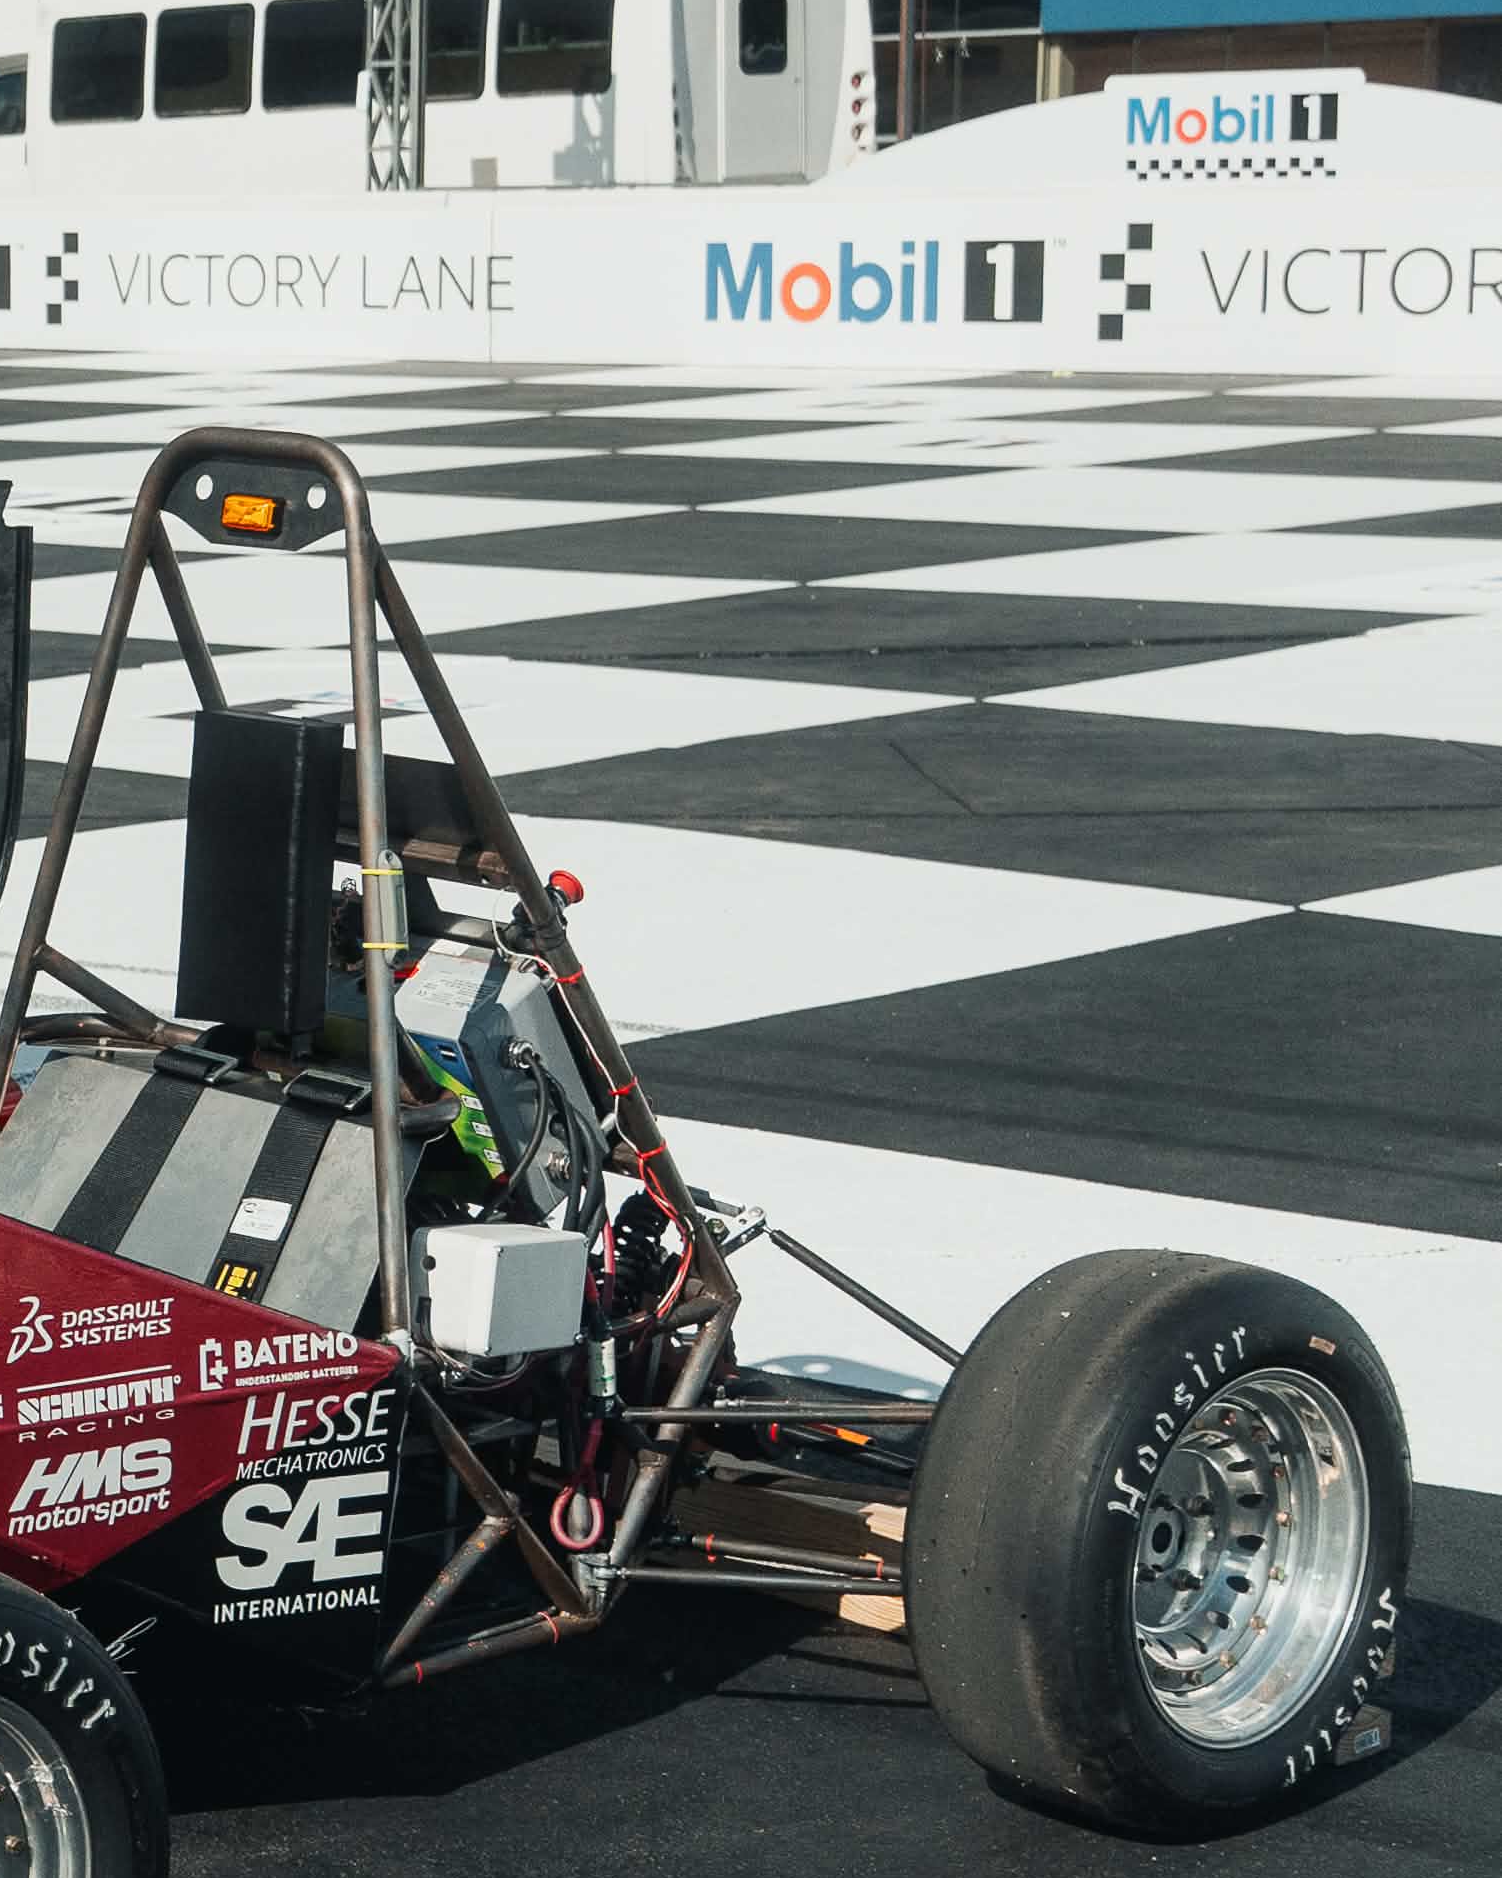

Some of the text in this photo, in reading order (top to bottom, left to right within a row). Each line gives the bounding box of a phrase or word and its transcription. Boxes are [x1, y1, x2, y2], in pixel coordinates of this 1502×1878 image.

[1127, 95, 1274, 144] Mobil
[108, 254, 514, 311] VICTORY LANE
[705, 240, 939, 323] Mobil
[60, 1297, 174, 1329] DASSAULT
[234, 1331, 358, 1370] BATEMO
[17, 1375, 177, 1426] SCHROTH
[235, 1364, 359, 1388] UNDERSTANDING BATTERIES
[18, 1408, 176, 1444] RACING
[236, 1388, 397, 1456] HESSE
[1107, 1325, 1247, 1520] Hoosier
[9, 1437, 173, 1513] HMS
[235, 1442, 388, 1481] MECHATRONICS
[8, 1487, 171, 1537] motorsport
[214, 1471, 390, 1591] SAE
[213, 1585, 381, 1625] INTERNATIONAL
